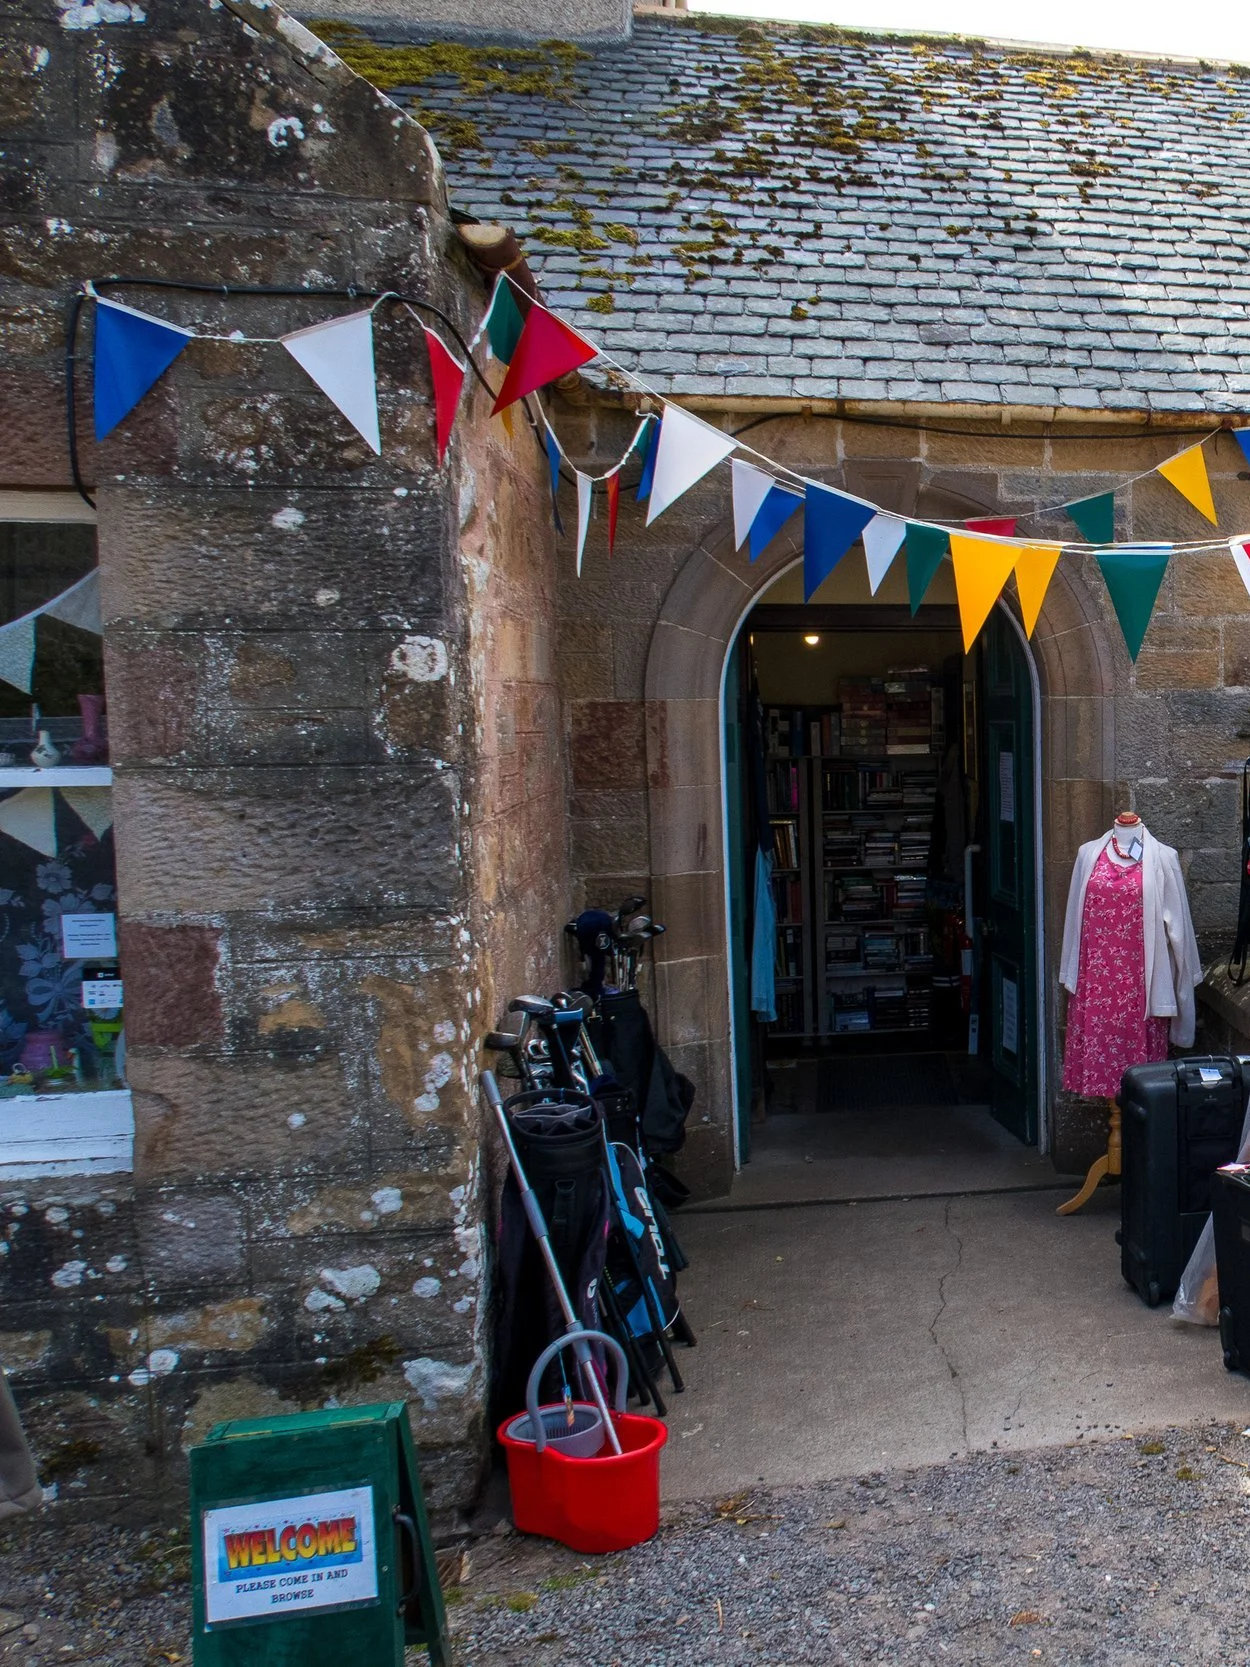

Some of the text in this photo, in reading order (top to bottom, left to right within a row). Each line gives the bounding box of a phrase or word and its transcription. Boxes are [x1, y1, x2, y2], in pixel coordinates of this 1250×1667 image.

[224, 1516, 357, 1569] WELCOME
[235, 1568, 348, 1594] PLEASE COME IN AND
[271, 1588, 315, 1604] BROWSE
